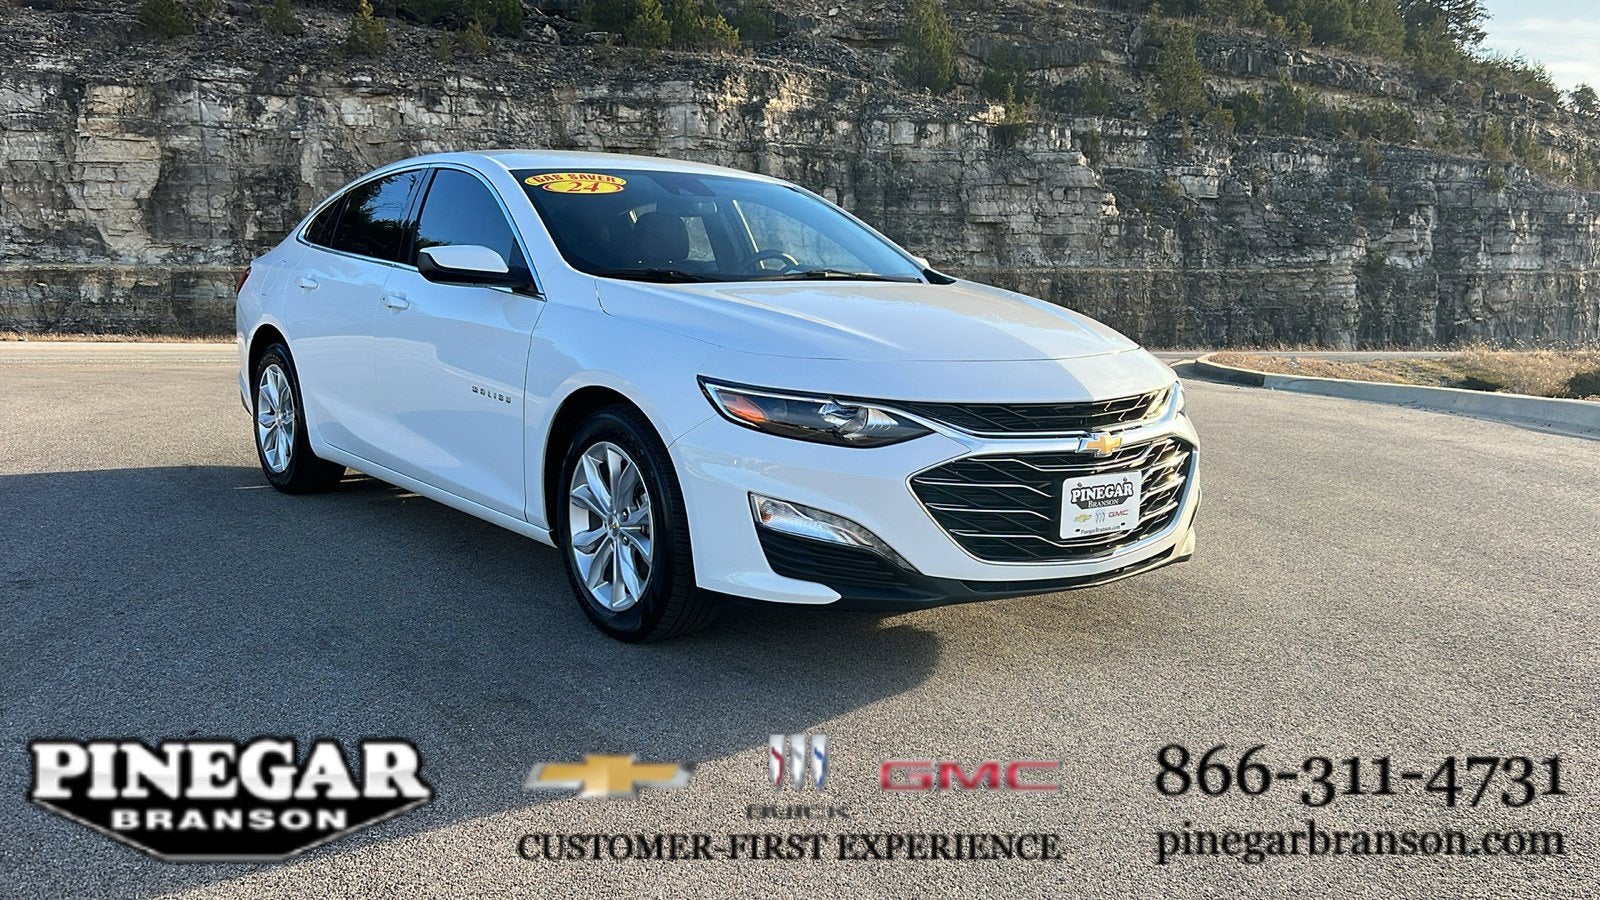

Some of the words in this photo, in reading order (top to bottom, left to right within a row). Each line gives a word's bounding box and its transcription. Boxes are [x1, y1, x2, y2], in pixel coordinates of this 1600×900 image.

[533, 174, 563, 183] GAS
[568, 173, 616, 183] SAVER
[567, 181, 600, 192] 24
[1071, 482, 1133, 504] PINEGAR
[1108, 510, 1129, 518] GMC
